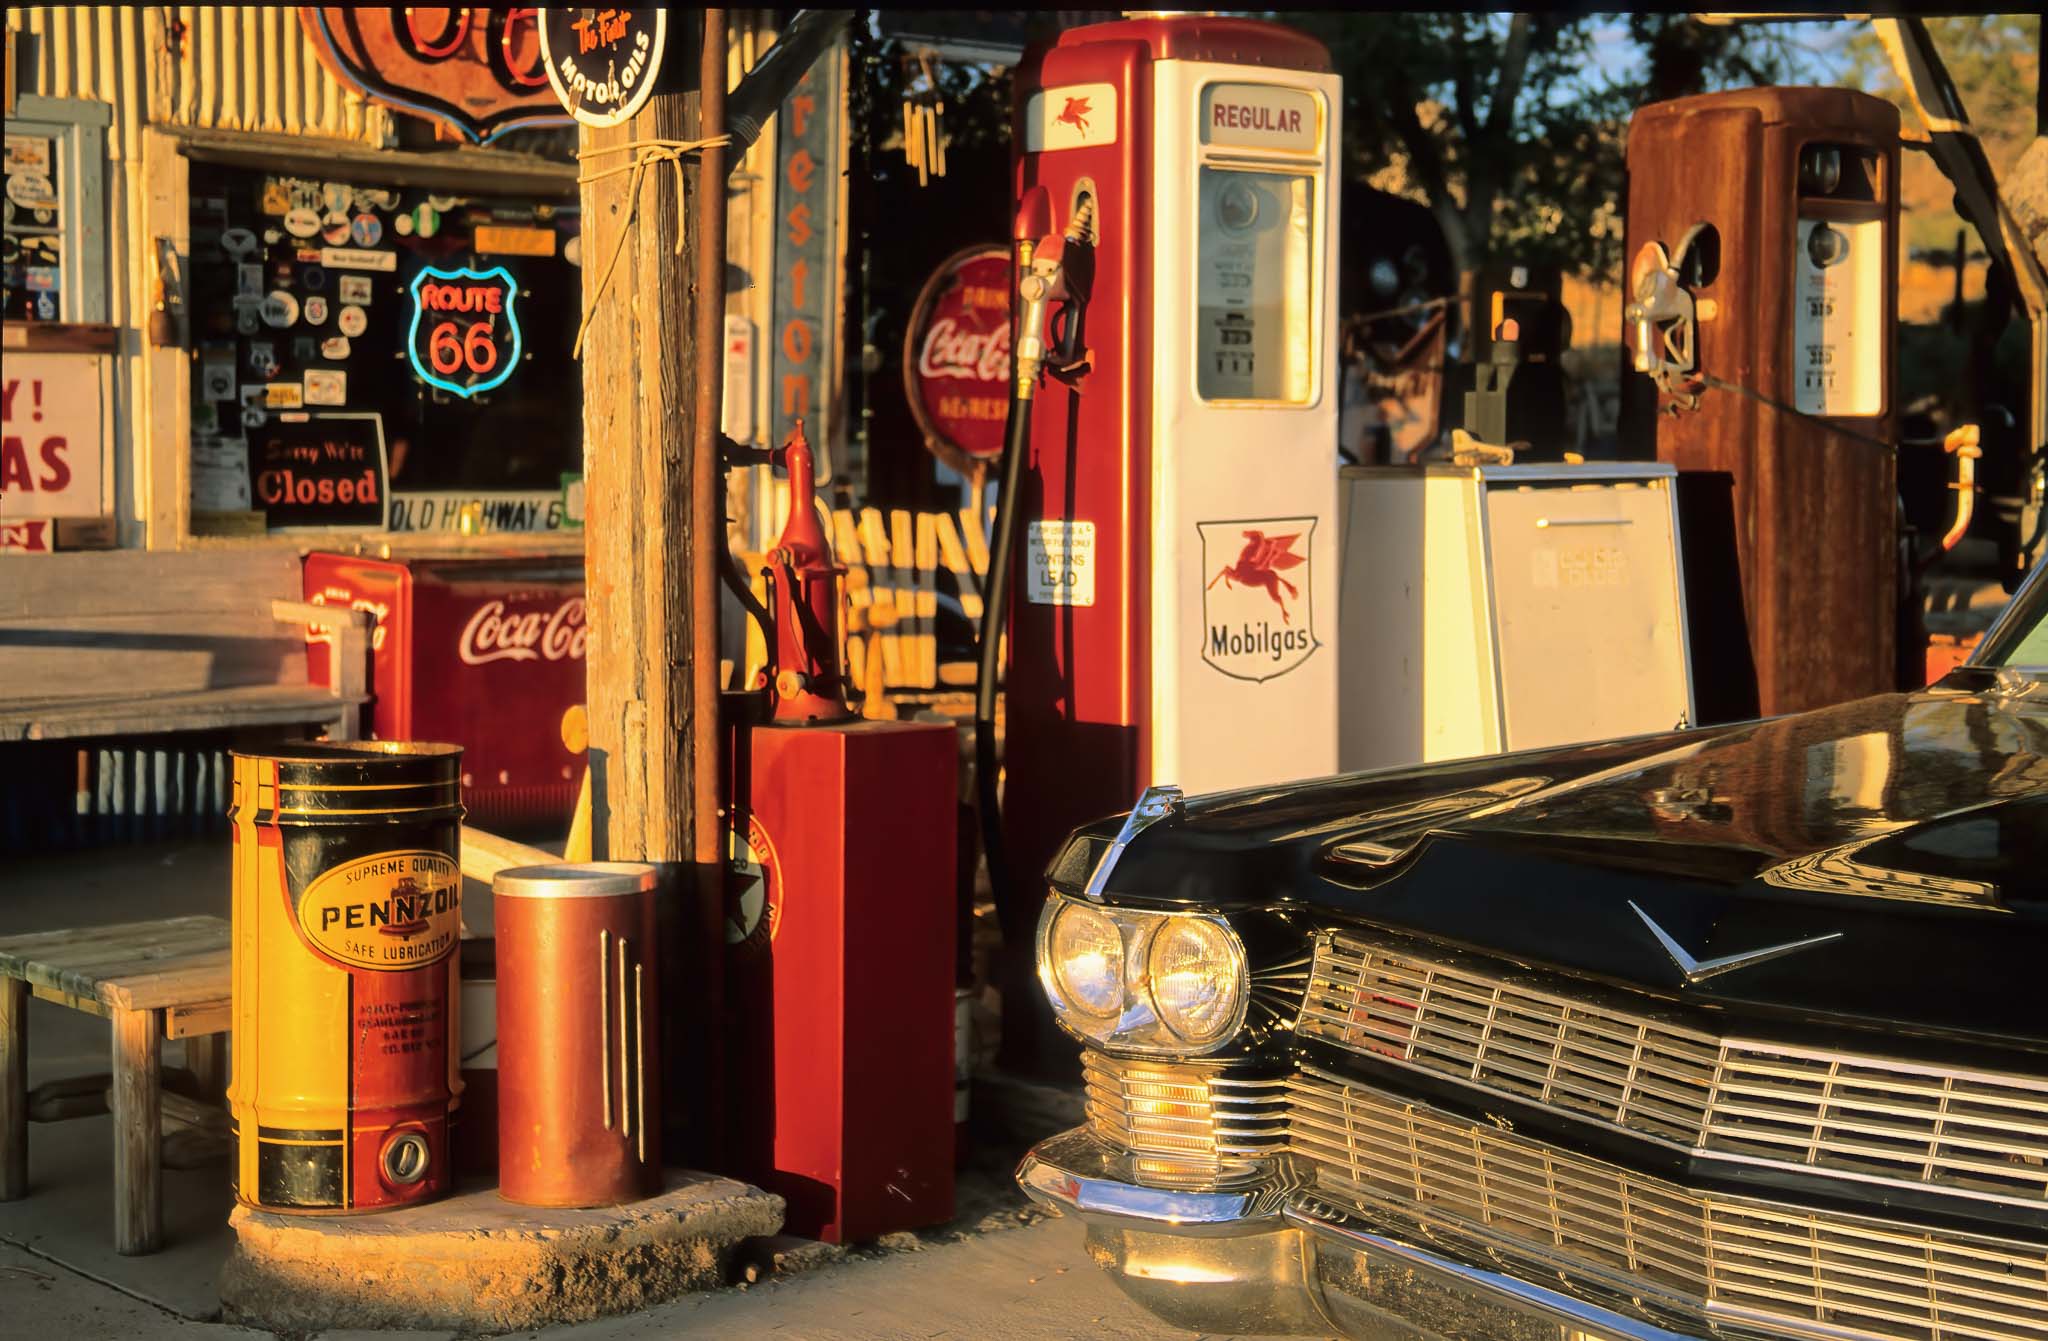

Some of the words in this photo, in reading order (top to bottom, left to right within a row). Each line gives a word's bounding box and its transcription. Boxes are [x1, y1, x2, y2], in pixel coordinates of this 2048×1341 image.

[560, 56, 620, 105] MOTOR
[622, 30, 650, 89] OILS
[1214, 103, 1301, 133] REGULAR
[421, 283, 502, 314] ROUTE
[430, 322, 497, 375] 66
[2, 380, 43, 423] Y!
[2, 436, 71, 493] AS
[258, 468, 378, 504] Closed
[389, 499, 435, 532] OLD
[441, 498, 542, 531] HIHWAY
[1035, 553, 1085, 566] CONTAINS
[1041, 570, 1078, 587] LEAD
[1211, 622, 1308, 661] Mobilgas
[345, 860, 405, 885] SUPREME
[412, 858, 450, 877] QUALITY
[322, 883, 459, 932] PENNZOIL
[344, 940, 375, 958] SAFE
[383, 931, 450, 960] LUBRICATION
